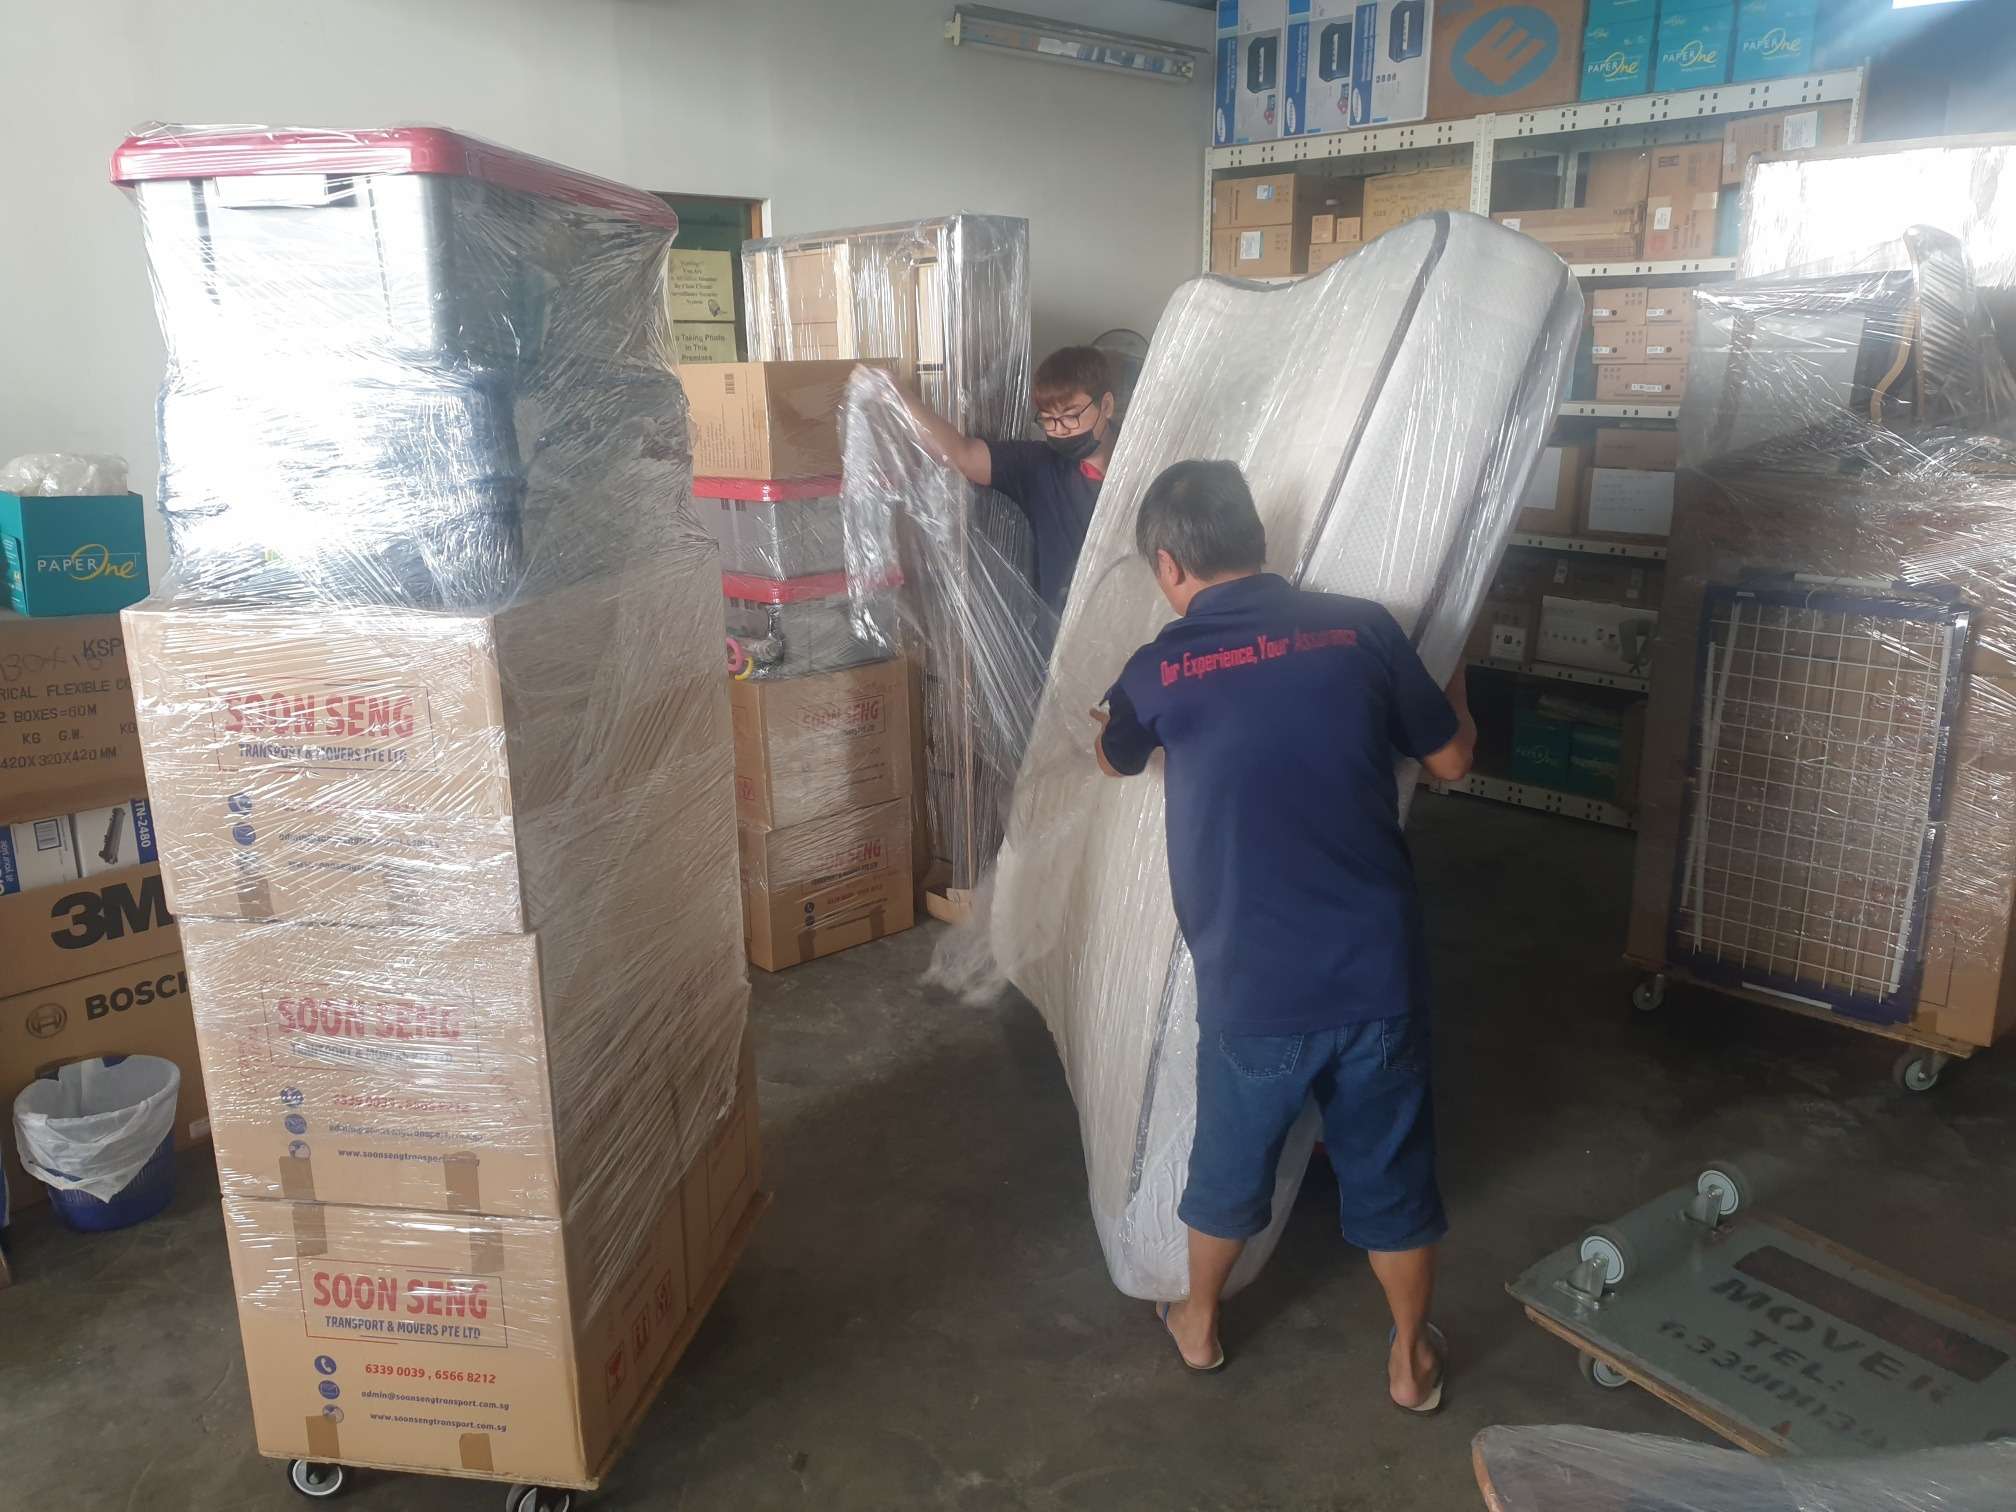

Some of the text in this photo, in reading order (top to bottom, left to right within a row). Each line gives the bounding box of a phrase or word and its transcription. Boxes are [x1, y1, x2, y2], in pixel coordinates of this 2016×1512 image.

[37, 543, 142, 582] PAPER One
[1160, 659, 1181, 687] Our
[1183, 645, 1258, 680] Experience,
[1257, 633, 1290, 660] Your
[47, 679, 110, 698] FLEXIBLE
[225, 691, 414, 738] SOON SENG
[133, 799, 151, 848] TN-2480
[50, 874, 174, 951] 3M
[278, 995, 365, 1038] SOON
[313, 1271, 488, 1320] SOON SENG
[325, 1315, 481, 1340] TRANSPORT & MOVERS PTE LTD
[365, 1363, 394, 1376] 6339
[396, 1366, 426, 1379] 0039
[434, 1369, 464, 1383] 6566
[466, 1372, 497, 1385] 8212
[1746, 1328, 1846, 1393] TEL:
[361, 1390, 510, 1411] admin@soonsengtransport.com.sg
[370, 1414, 508, 1432] www.soonsengtransport.com.sg
